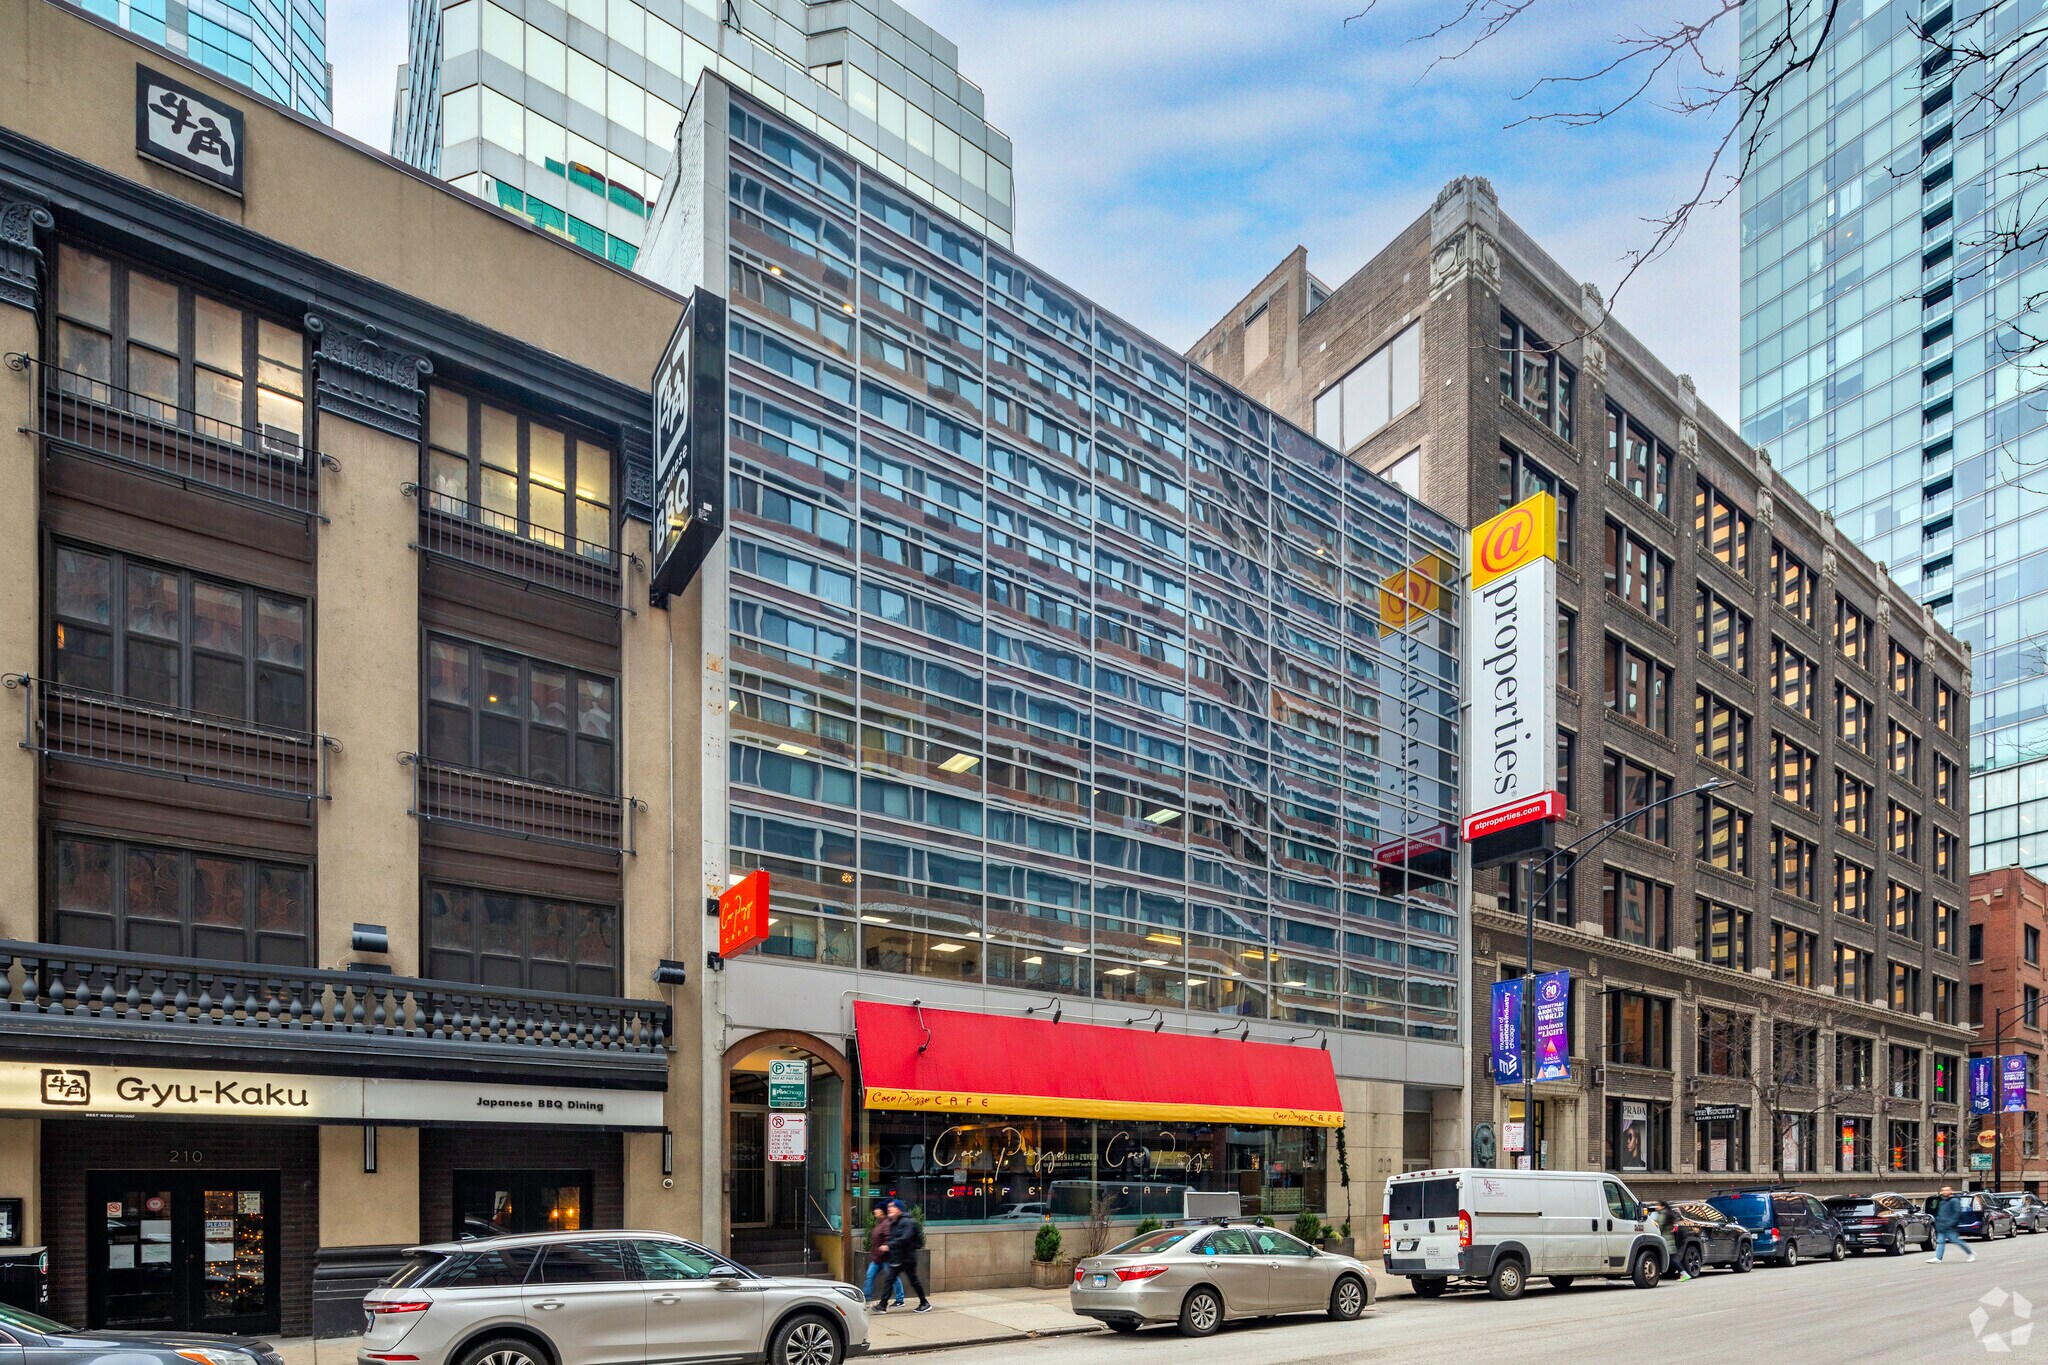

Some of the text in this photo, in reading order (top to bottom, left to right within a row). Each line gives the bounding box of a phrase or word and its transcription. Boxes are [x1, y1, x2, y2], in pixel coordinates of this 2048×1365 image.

[656, 444, 688, 509] Japanese
[656, 467, 689, 555] BBQ
[1481, 508, 1533, 573] @
[1483, 575, 1532, 796] properties
[1474, 804, 1541, 831] atproperties.com
[1546, 984, 1557, 996] 80
[1538, 1001, 1564, 1010] CHRISTMAS
[1538, 1012, 1564, 1021] WORLD
[1538, 1022, 1564, 1032] HOLIDAYS
[1542, 1028, 1564, 1038] LIGHT
[116, 1076, 310, 1108] Gyu-Kaku
[476, 1097, 604, 1112] Japanese BBQ Dining
[934, 1096, 988, 1107] CAFE
[1622, 1105, 1646, 1115] PRADA
[1310, 1114, 1341, 1122] CAFE
[933, 1126, 982, 1166] Coco
[1106, 1131, 1146, 1168] Coco
[170, 1150, 203, 1163] 210
